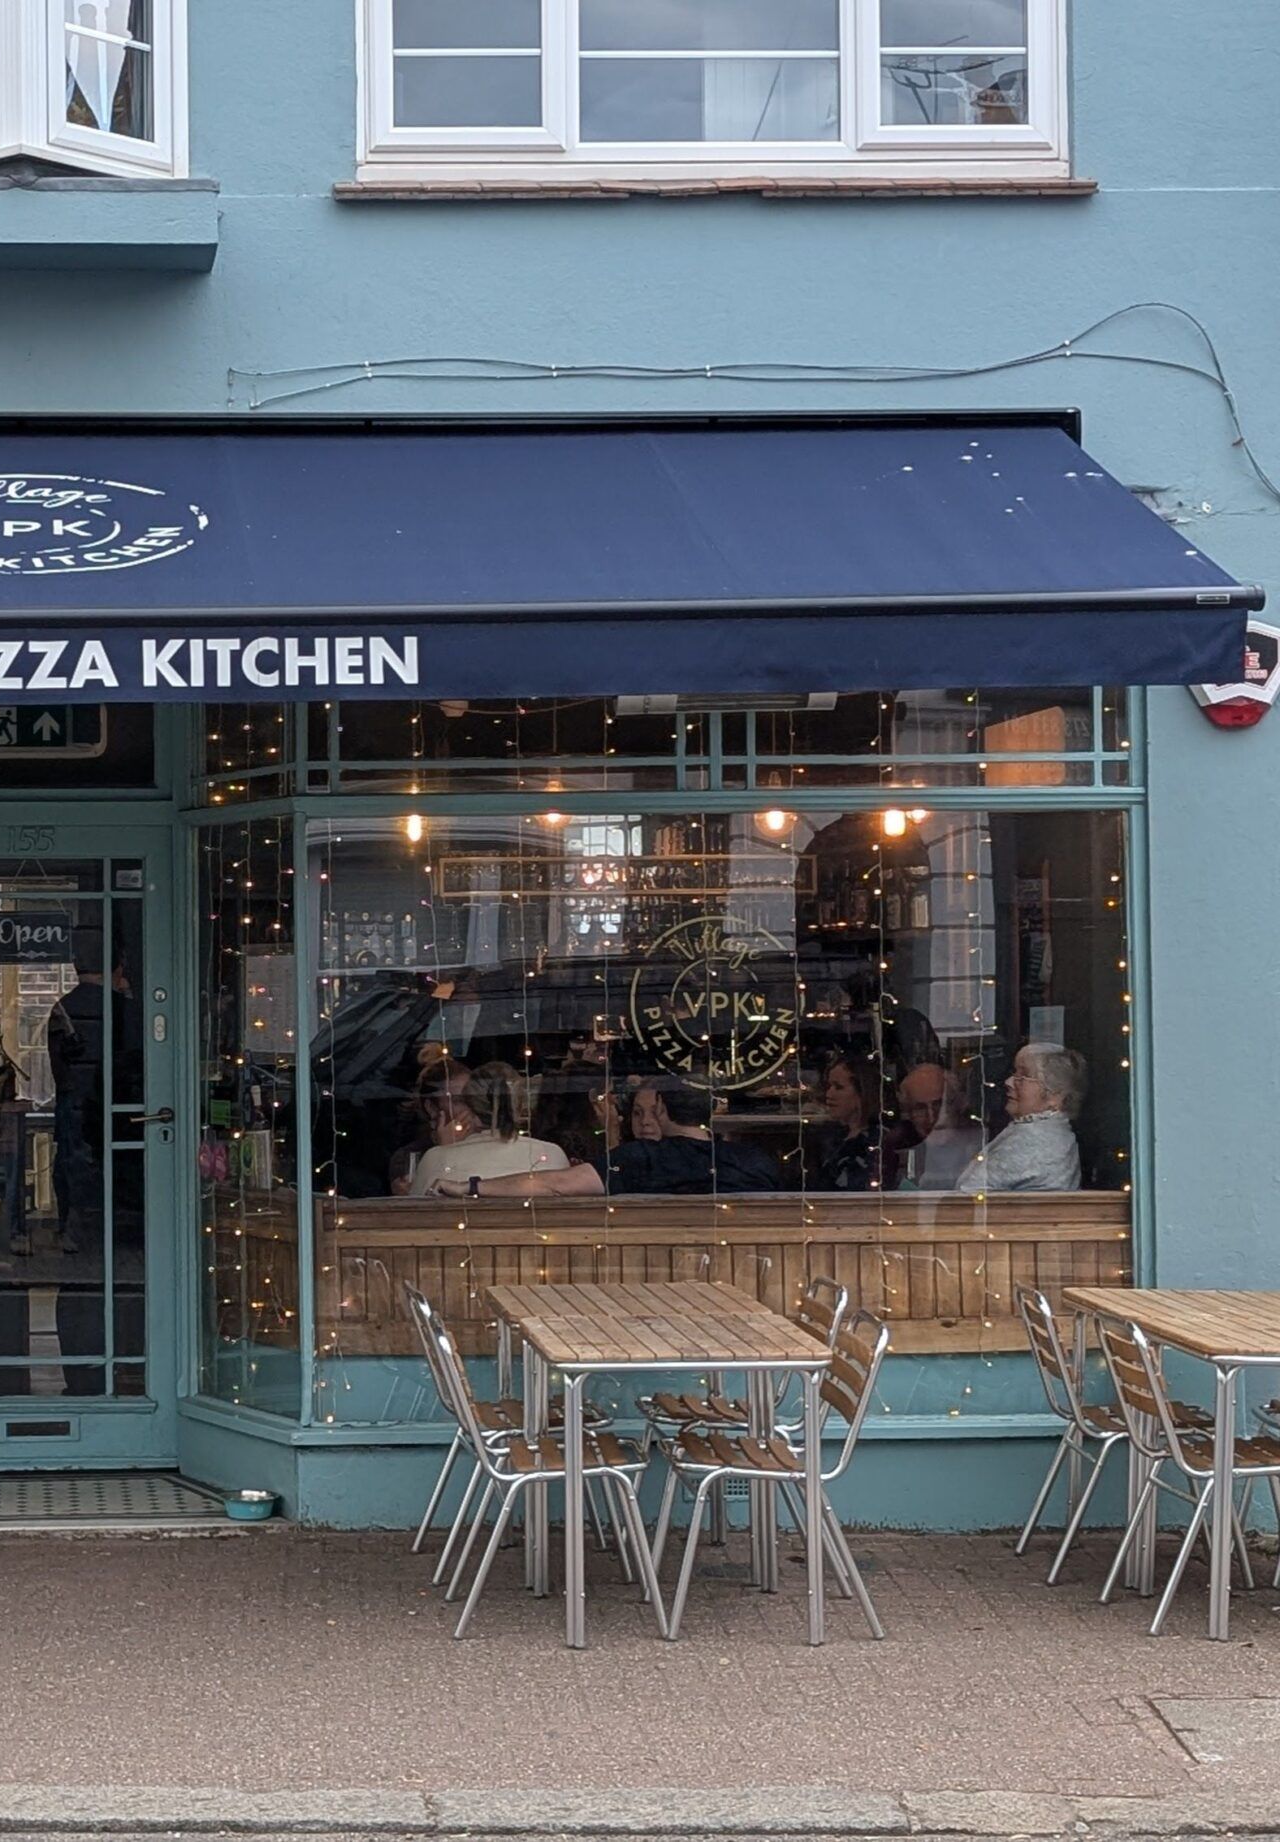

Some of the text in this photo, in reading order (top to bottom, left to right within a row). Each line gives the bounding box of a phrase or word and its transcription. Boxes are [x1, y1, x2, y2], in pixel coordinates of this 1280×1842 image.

[141, 635, 420, 688] KITCHEN
[6, 825, 56, 853] 155
[666, 924, 763, 971] Village
[682, 991, 753, 1018] VPK
[643, 1006, 796, 1079] PIZZA KITCHEN
